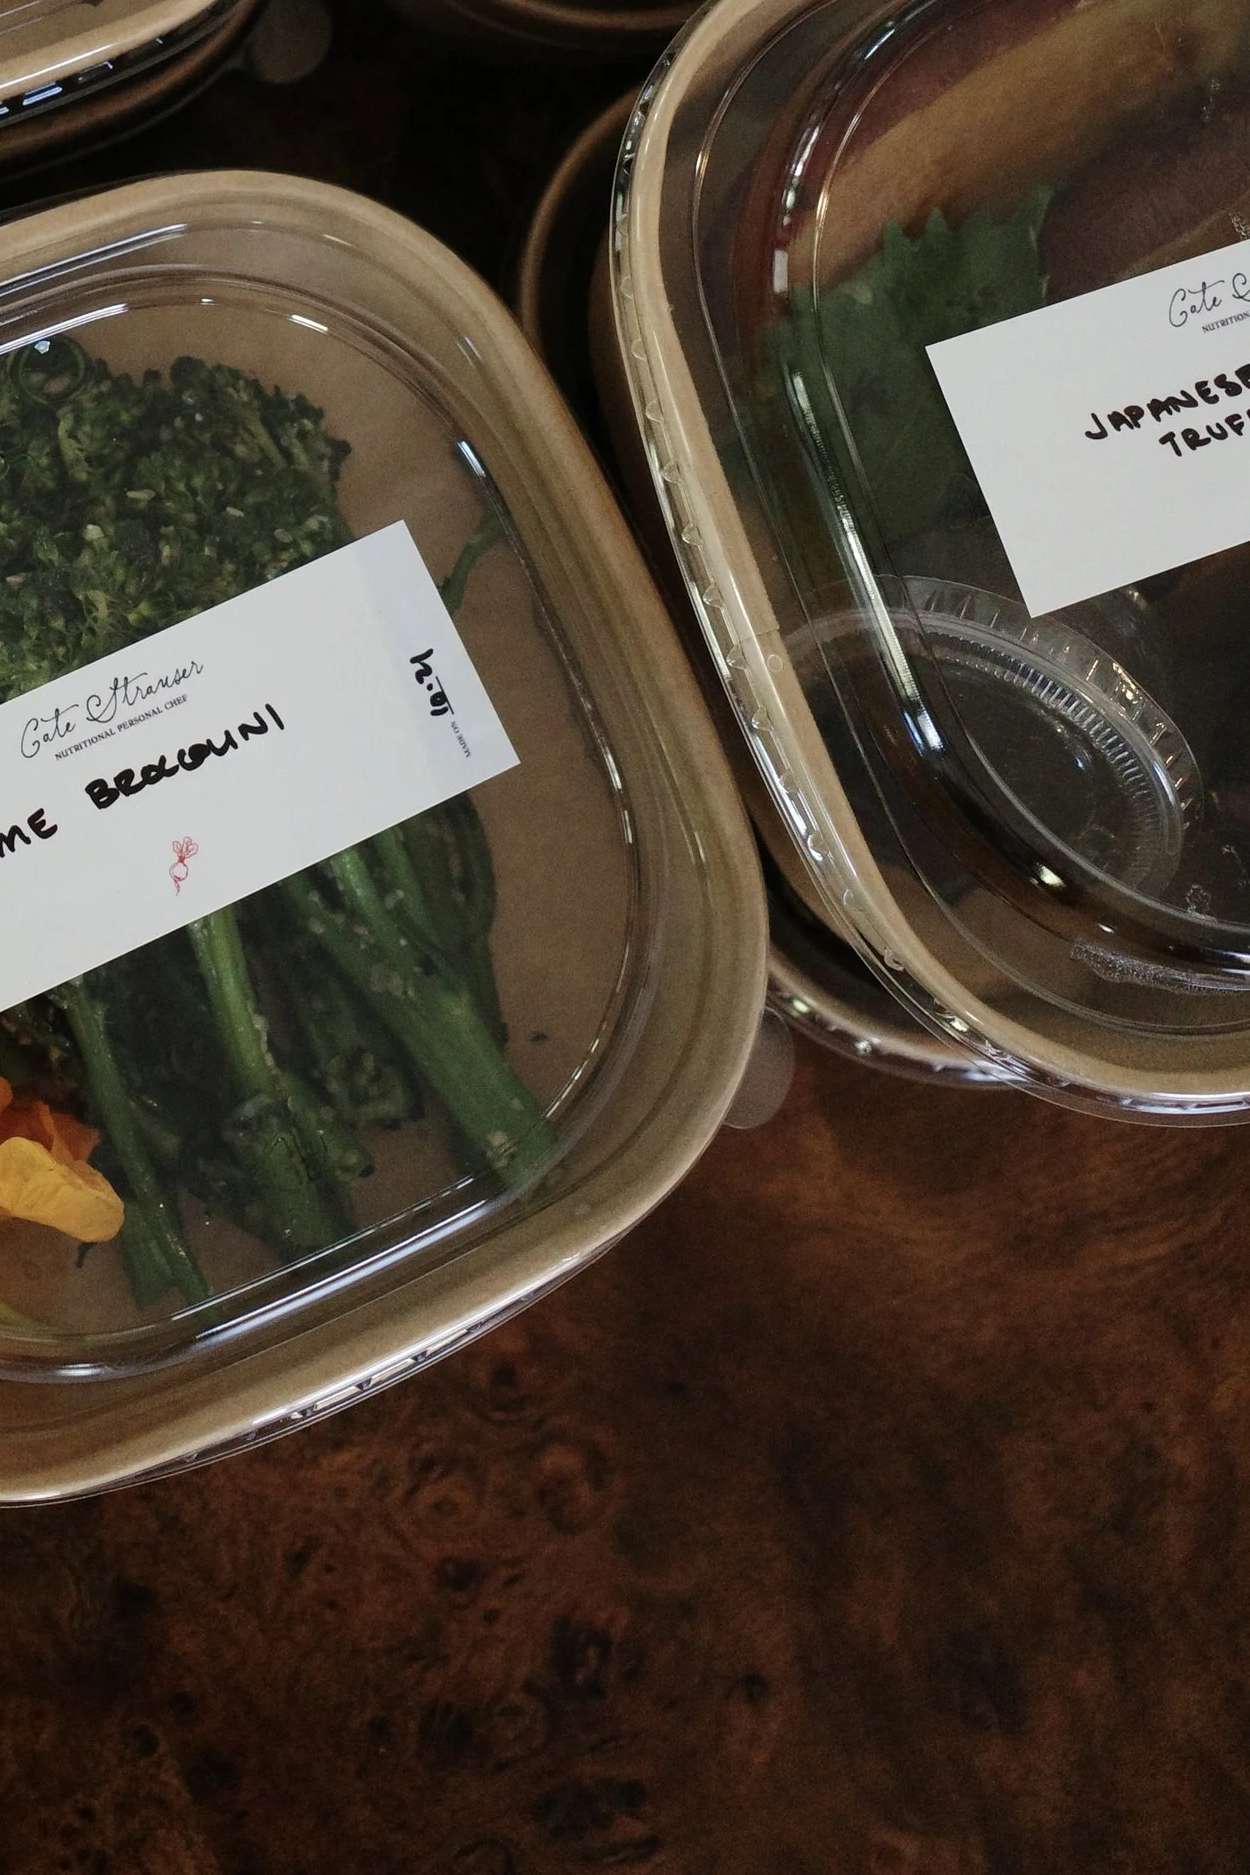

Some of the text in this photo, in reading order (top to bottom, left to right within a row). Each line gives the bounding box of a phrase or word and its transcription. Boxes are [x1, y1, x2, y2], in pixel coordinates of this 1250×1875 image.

[1202, 309, 1250, 333] NUTRITION
[1158, 408, 1250, 457] TRUF
[54, 693, 189, 761] NUTRITIONAL PERSONAL CHEF
